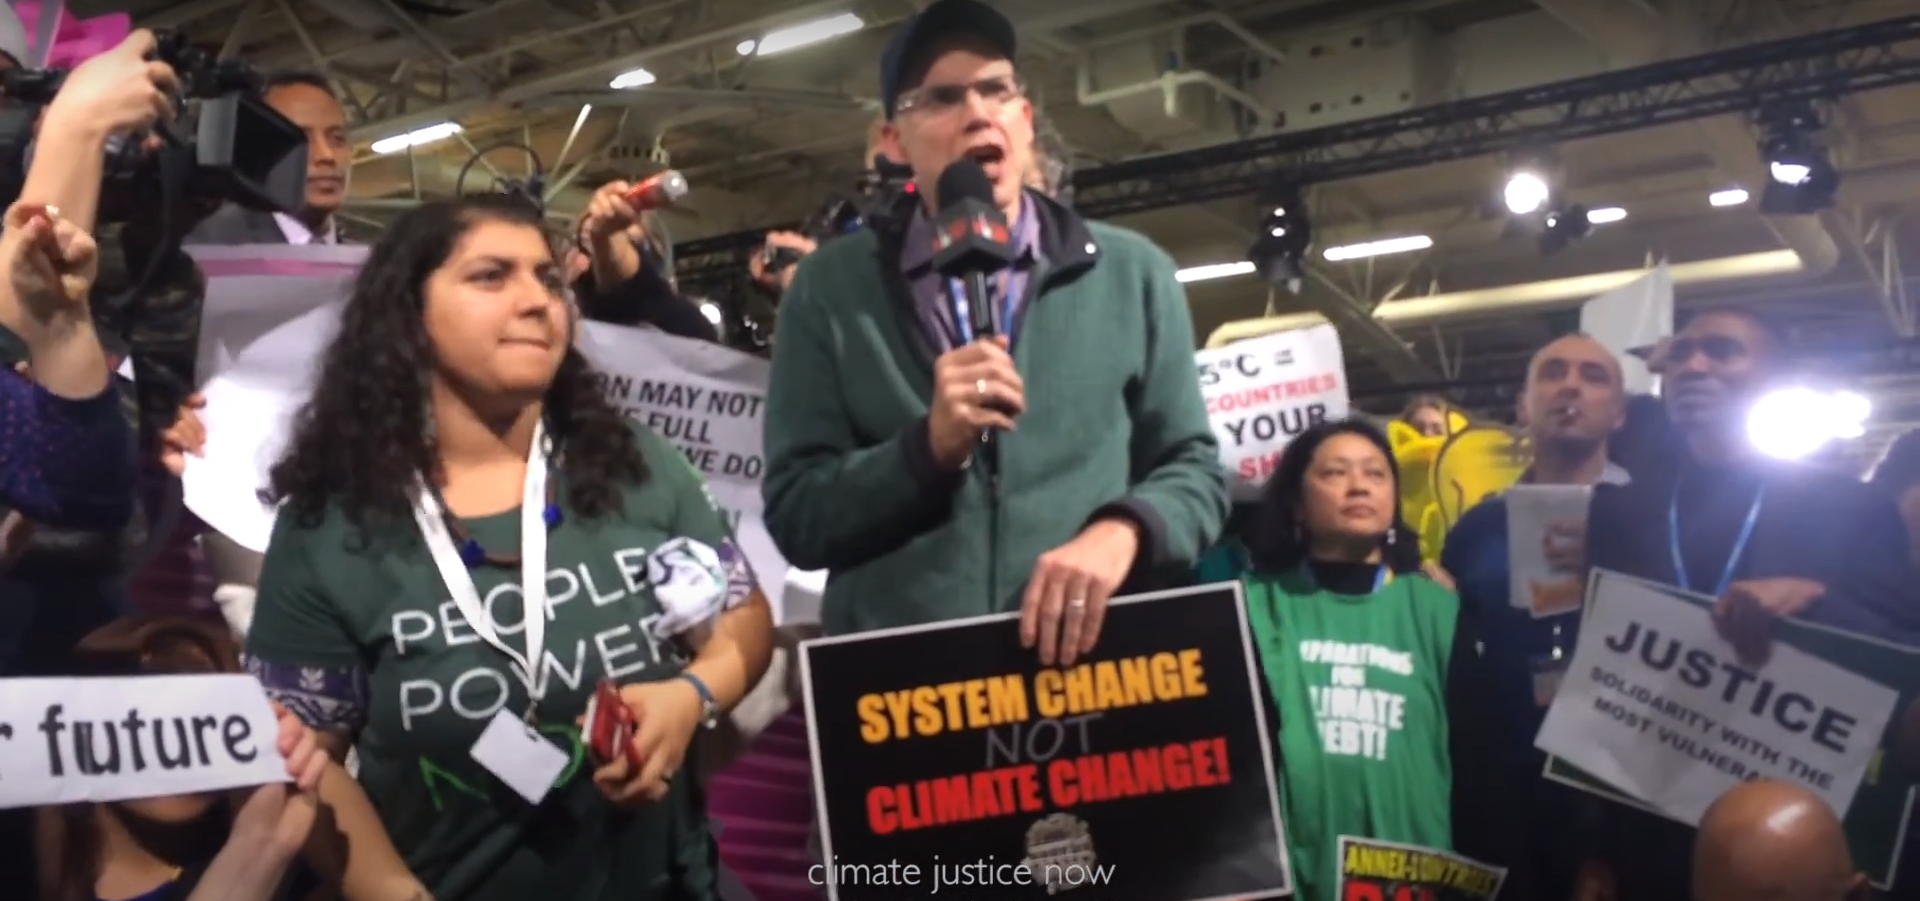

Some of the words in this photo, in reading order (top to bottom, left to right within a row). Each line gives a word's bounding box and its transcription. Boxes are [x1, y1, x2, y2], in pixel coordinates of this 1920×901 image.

[638, 380, 703, 410] MAY
[706, 390, 763, 419] NOT
[647, 411, 713, 445] FULL
[1223, 403, 1326, 447] YOUR
[722, 454, 763, 480] DO
[391, 547, 648, 655] PEOPLE
[856, 673, 1030, 744] SYSTEM
[1034, 647, 1208, 719] CHANGE
[1604, 620, 1858, 754] JUSTICE
[984, 713, 1105, 769] NOT
[1317, 720, 1388, 762] EBT!
[1590, 666, 1717, 736] SOLIDARITY
[1720, 724, 1781, 767] WITH
[1787, 754, 1835, 791] THE
[1593, 697, 1654, 734] MOST
[1657, 726, 1771, 784] VULNERA
[866, 763, 1044, 836] CLIMATE
[1047, 736, 1232, 808] CHANGE!
